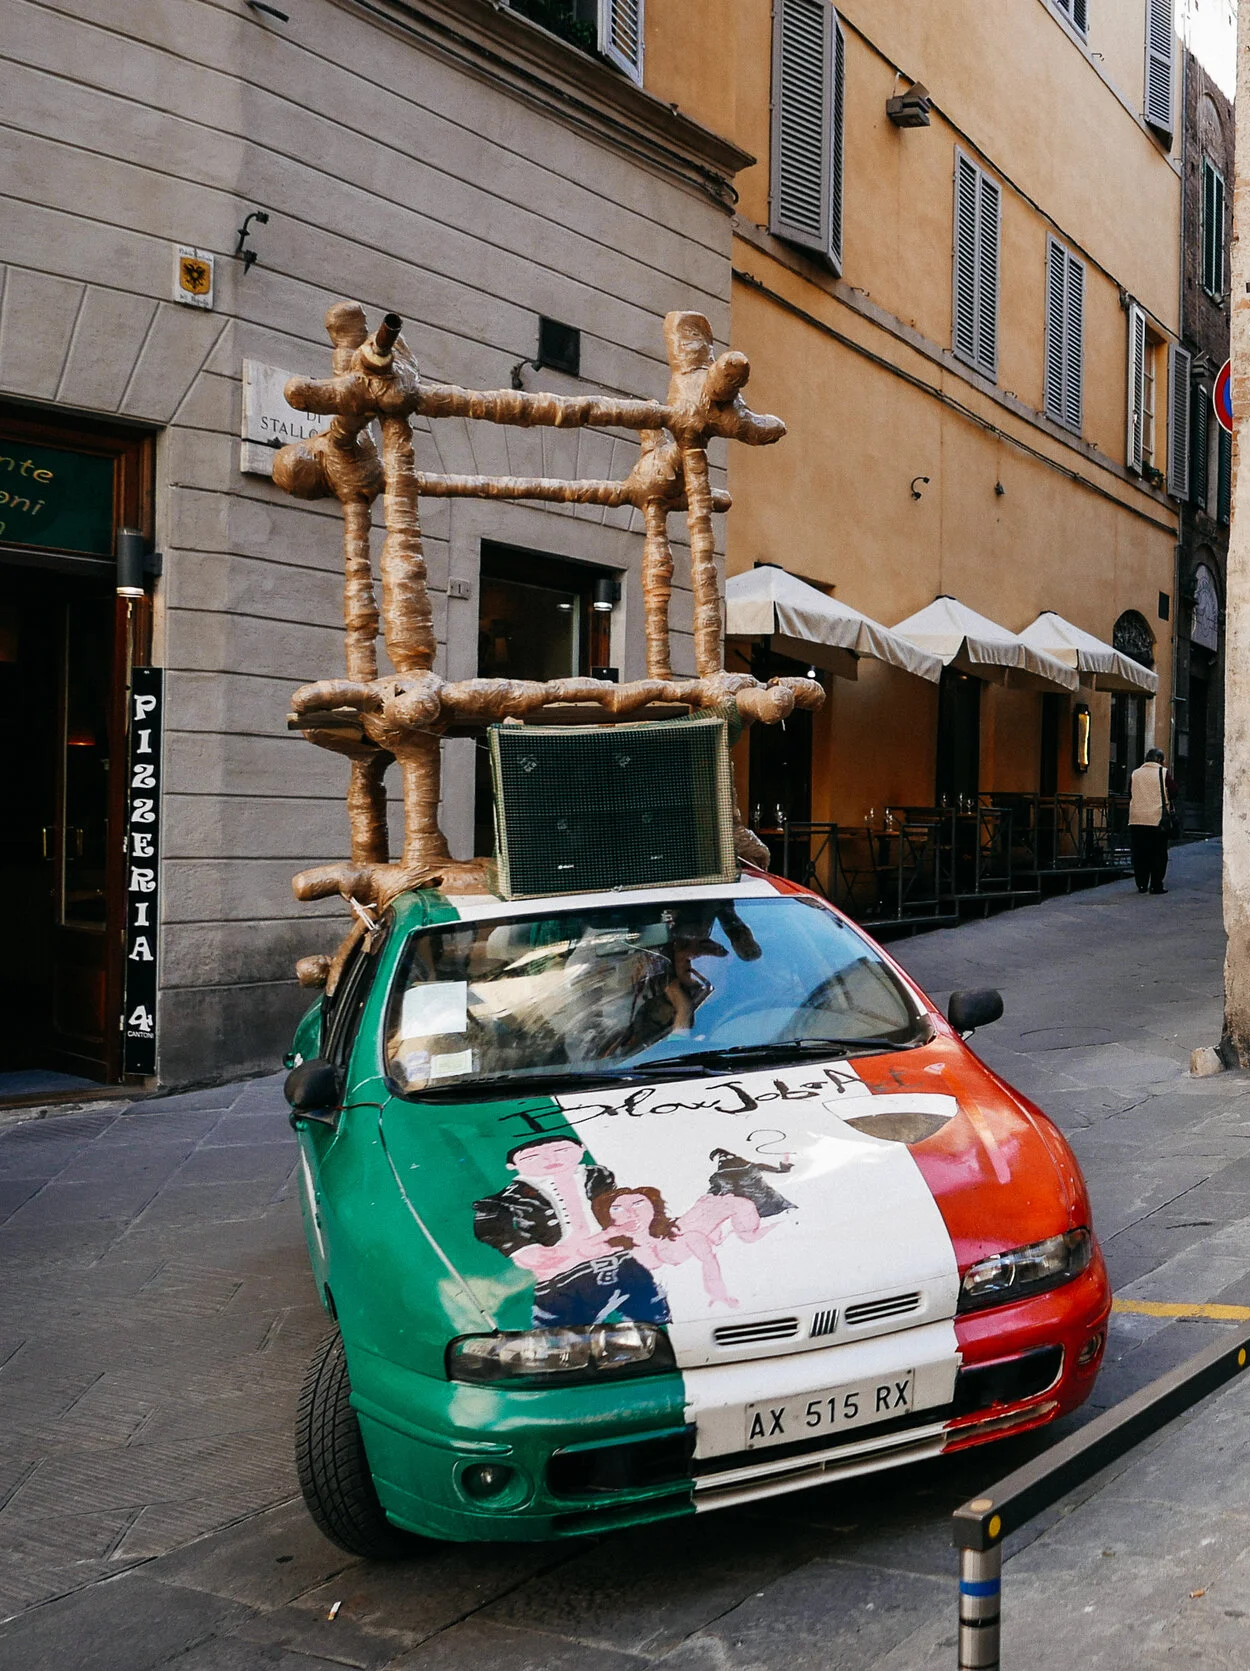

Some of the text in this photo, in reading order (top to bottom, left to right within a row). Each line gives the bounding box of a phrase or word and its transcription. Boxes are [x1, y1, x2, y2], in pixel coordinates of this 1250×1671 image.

[260, 416, 319, 439] STALLO
[0, 456, 54, 483] nte
[128, 694, 157, 961] PIZZERIA
[128, 1005, 153, 1032] 4
[750, 1380, 910, 1440] AX 515 RX
